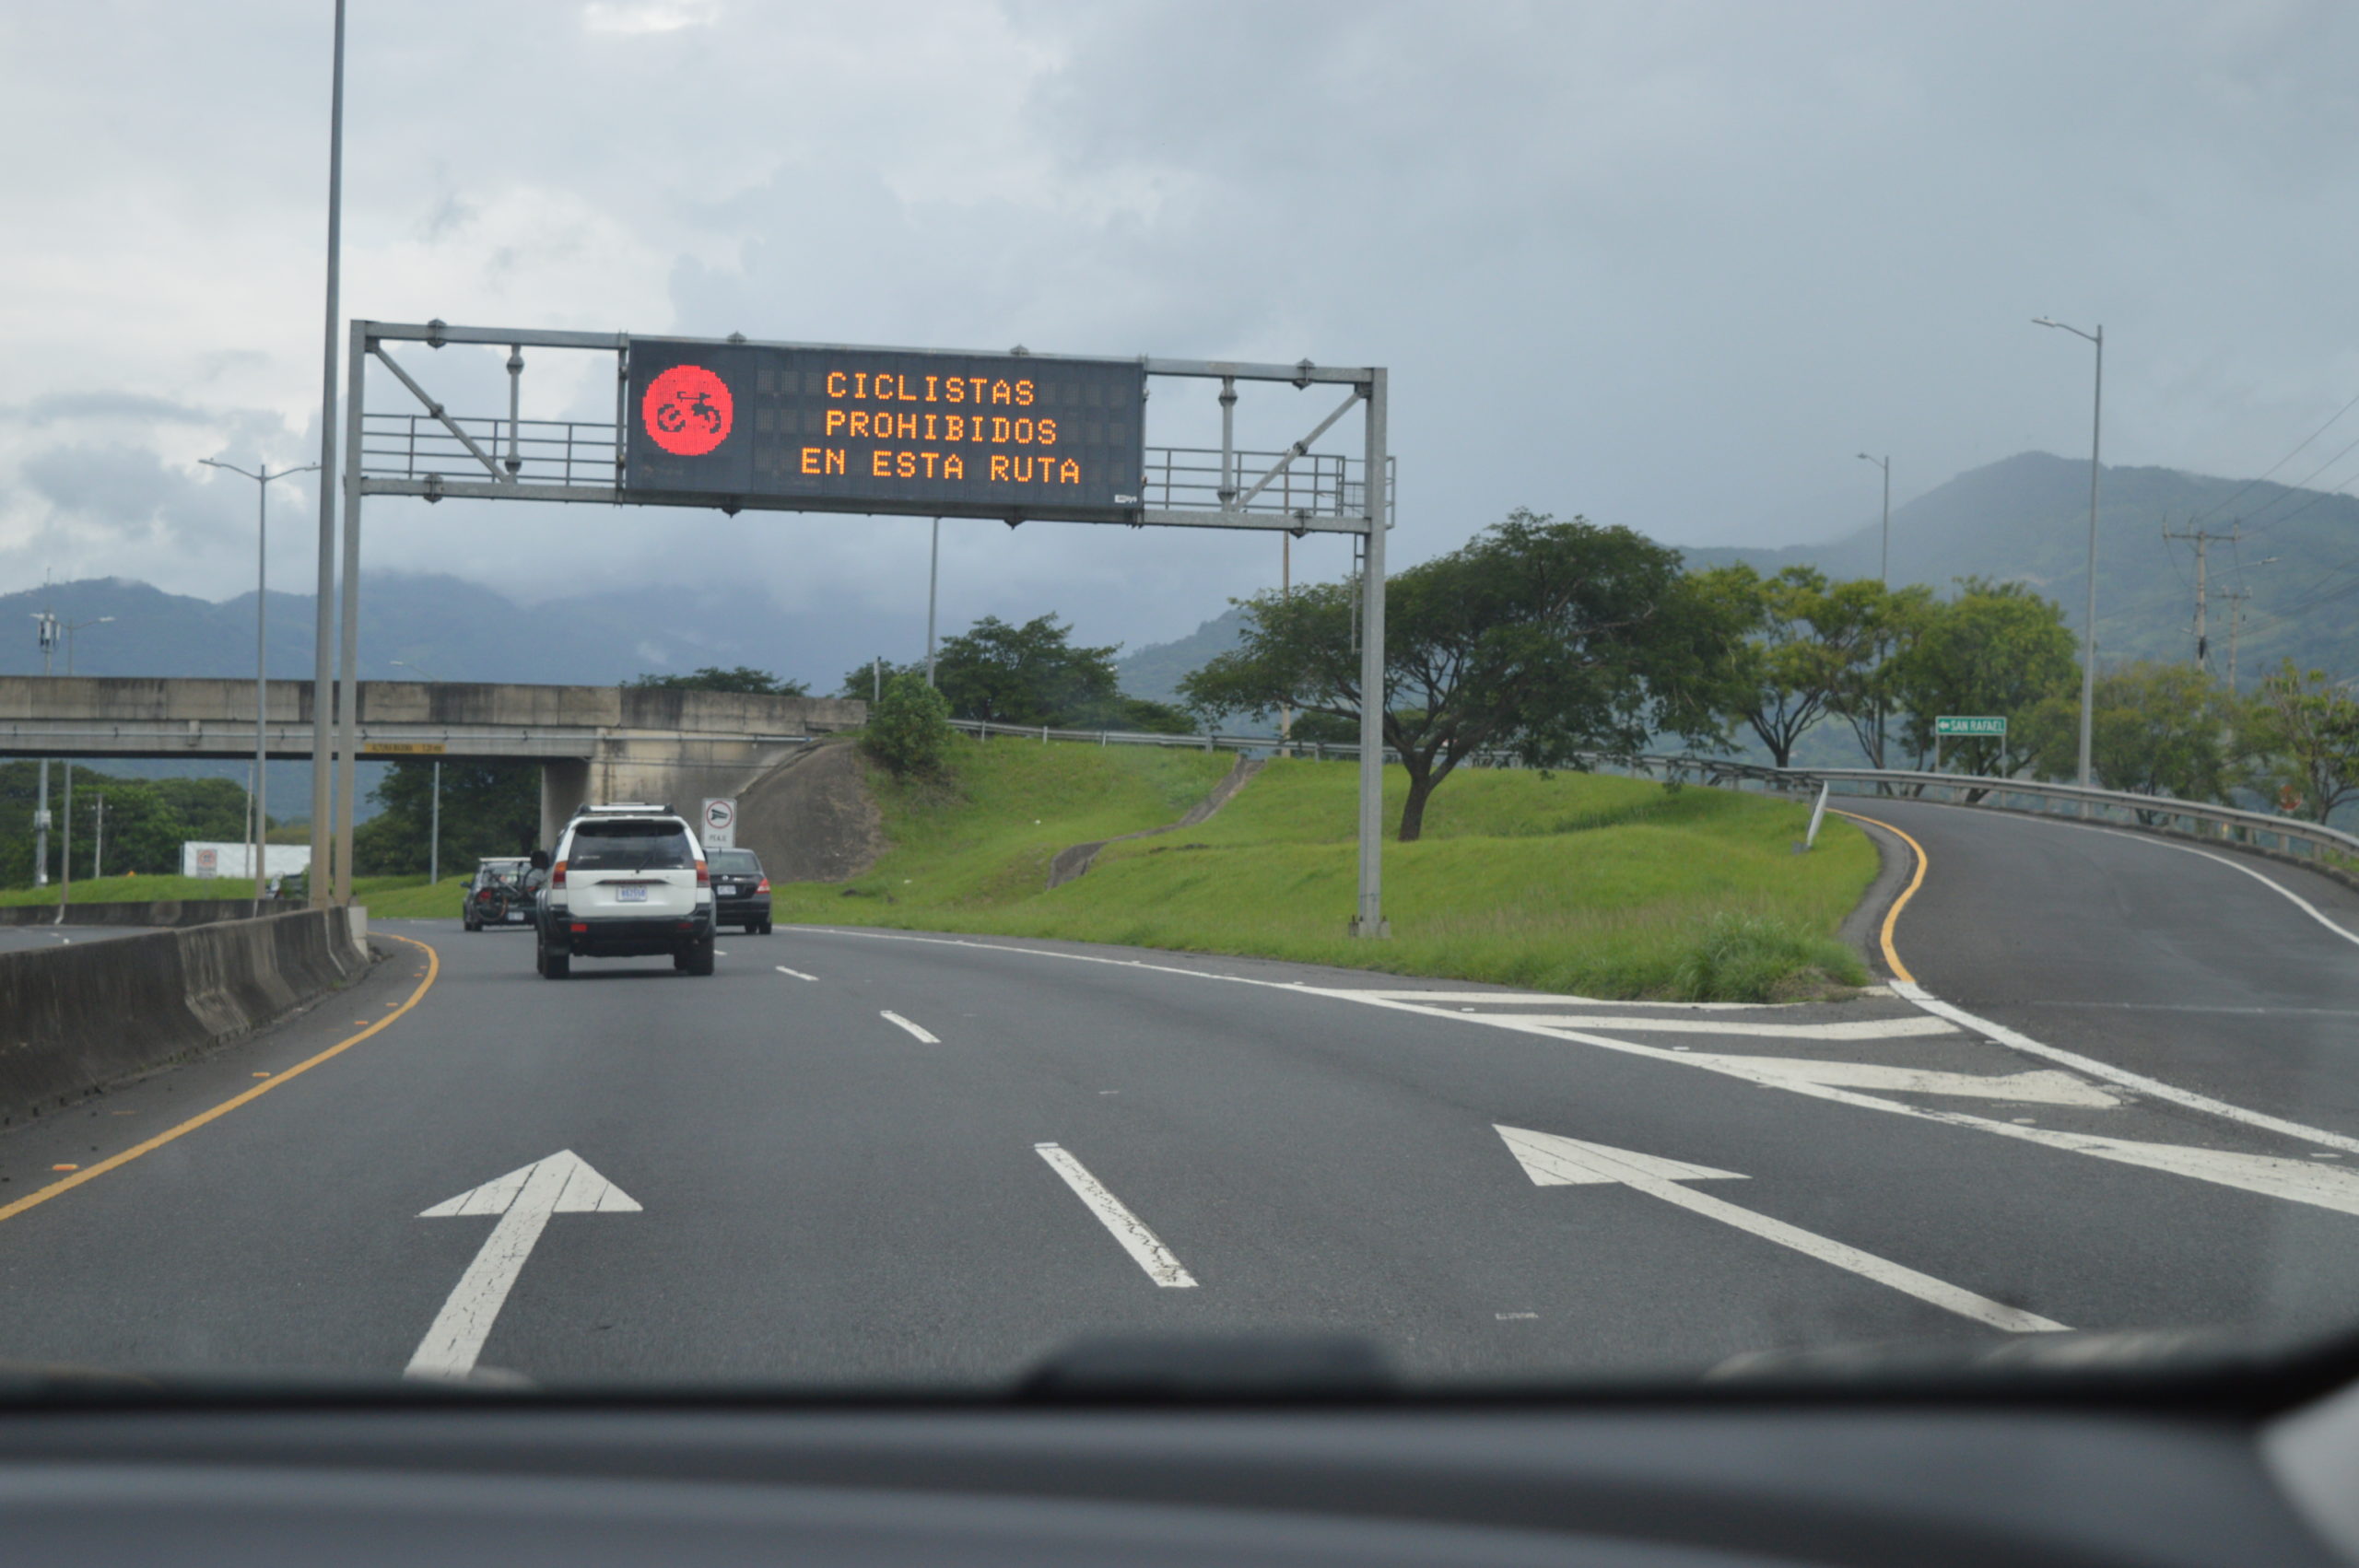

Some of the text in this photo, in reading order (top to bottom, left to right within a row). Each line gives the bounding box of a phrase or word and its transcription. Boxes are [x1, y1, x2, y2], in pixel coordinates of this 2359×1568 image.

[827, 371, 1034, 406] CICLISTAS
[826, 410, 1057, 445] PROHIBIDOS
[801, 447, 1080, 485] EN ESTA RUTA
[1950, 720, 2004, 732] SAN RAFAEL
